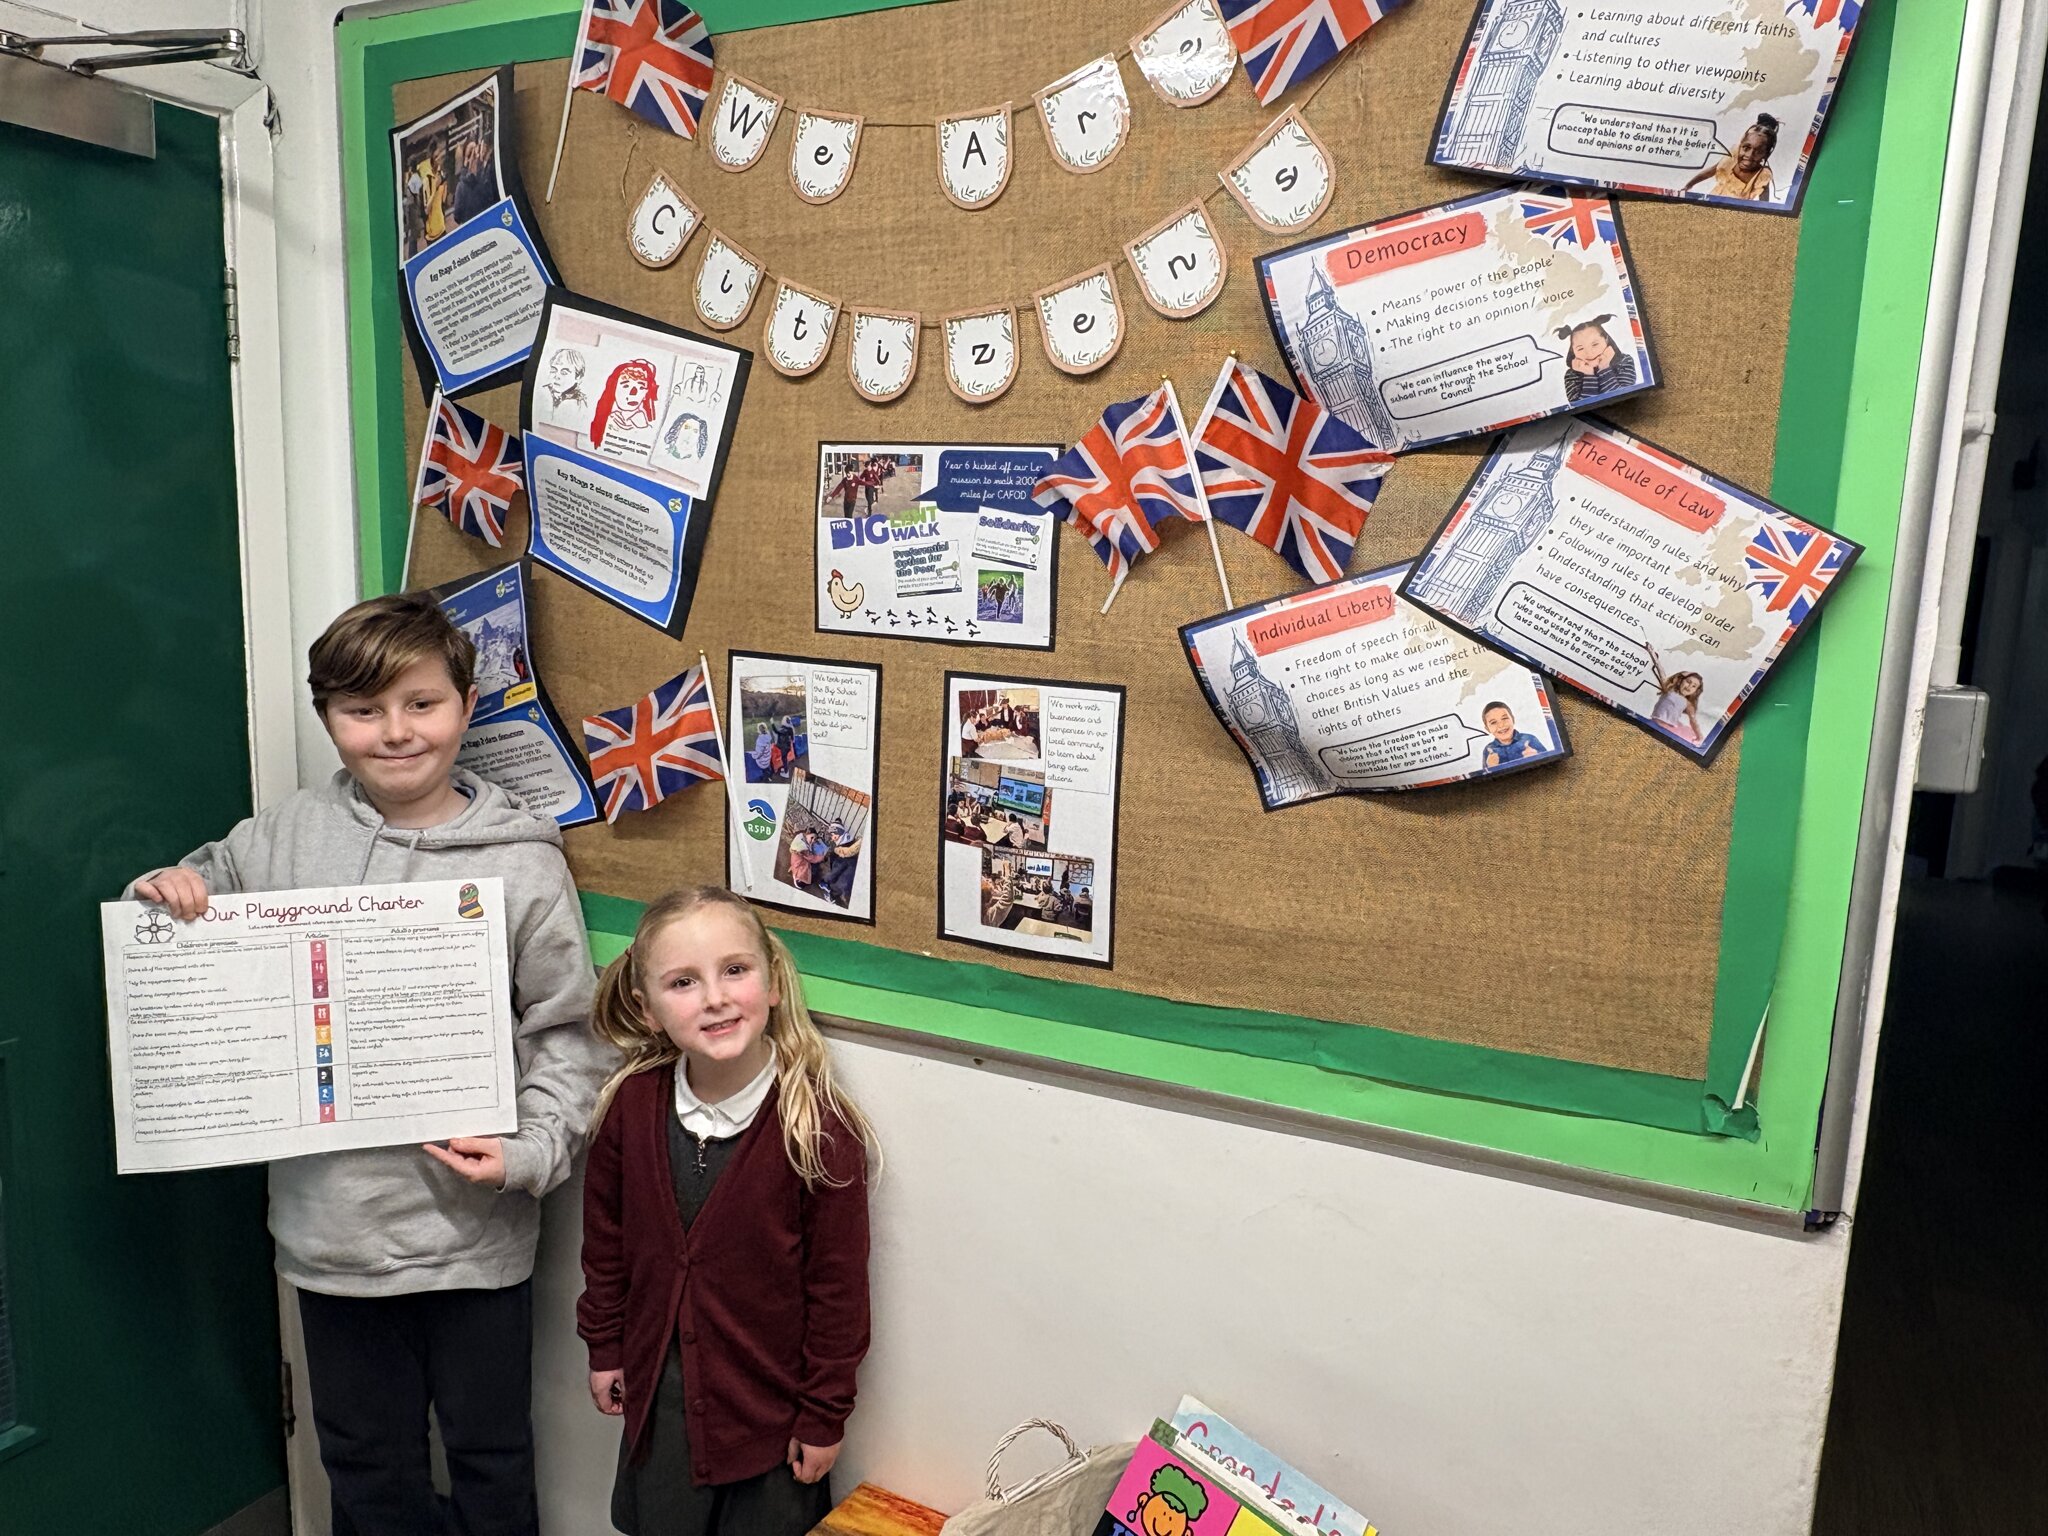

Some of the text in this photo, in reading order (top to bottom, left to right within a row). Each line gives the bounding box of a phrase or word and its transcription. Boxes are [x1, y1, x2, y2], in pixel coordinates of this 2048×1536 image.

[1582, 31, 1661, 47] and cultures
[1590, 9, 1796, 38] Learning about different faiths
[1569, 71, 1725, 104] Learning about diversity
[1575, 50, 1767, 83] Listening to other viewpoints
[1557, 123, 1616, 138] unacceptable
[1620, 130, 1630, 139] to
[1667, 136, 1682, 146] the
[1578, 137, 1594, 146] and
[1597, 140, 1632, 152] opinions
[1636, 144, 1645, 152] of
[1600, 117, 1653, 131] understand
[1657, 124, 1677, 135] that
[1680, 127, 1689, 135] it
[1691, 128, 1698, 137] is
[1347, 225, 1467, 269] Democracy
[1382, 293, 1421, 313] Means
[1470, 274, 1482, 287] of
[1488, 270, 1508, 282] the
[1386, 278, 1544, 331] Making decisions together
[1390, 336, 1413, 350] The
[1417, 324, 1445, 341] right
[1449, 319, 1461, 331] to
[1467, 315, 1481, 326] an
[1543, 289, 1574, 304] voice
[1390, 357, 1528, 403] school runs through the School
[1415, 375, 1431, 387] can
[1433, 364, 1473, 381] influence
[1476, 358, 1492, 369] the
[1494, 353, 1513, 365] way
[945, 460, 963, 469] Year
[965, 461, 970, 469] 6
[972, 461, 997, 470] kicked
[999, 462, 1011, 473] off
[993, 477, 1013, 485] walk
[1577, 441, 1714, 518] The Rule of Law
[960, 490, 1026, 501] miles for CAFOD
[830, 514, 889, 549] BIG
[891, 522, 940, 541] WALK
[979, 516, 1040, 536] Solidarity
[1569, 515, 1670, 575] they are important
[1581, 499, 1746, 592] Understanding rules and why
[1537, 563, 1639, 627] have consequences
[1548, 547, 1721, 649] Understanding that actions can
[1558, 531, 1735, 633] Following rules to develop order
[1253, 594, 1392, 644] Individual Liberty
[1513, 601, 1642, 677] rules are used to mirror society
[1514, 611, 1532, 627] laws
[1533, 623, 1549, 635] and
[1550, 631, 1569, 645] must
[1571, 644, 1579, 652] be
[1537, 602, 1582, 631] understand
[1584, 627, 1604, 642] that
[1606, 639, 1619, 651] the
[1621, 647, 1648, 668] school
[1295, 620, 1437, 669] Freedom of speech for all
[1300, 636, 1449, 686] The right to make our own
[1307, 686, 1345, 703] choices
[1349, 681, 1360, 691] as
[1364, 670, 1389, 688] long
[1392, 667, 1405, 678] as
[1408, 661, 1424, 672] we
[1428, 649, 1469, 668] respect
[1312, 667, 1470, 720] other British Values and the
[1318, 706, 1402, 735] rights of others
[748, 823, 772, 835] RSPB
[202, 896, 424, 923] Our Playground Charter
